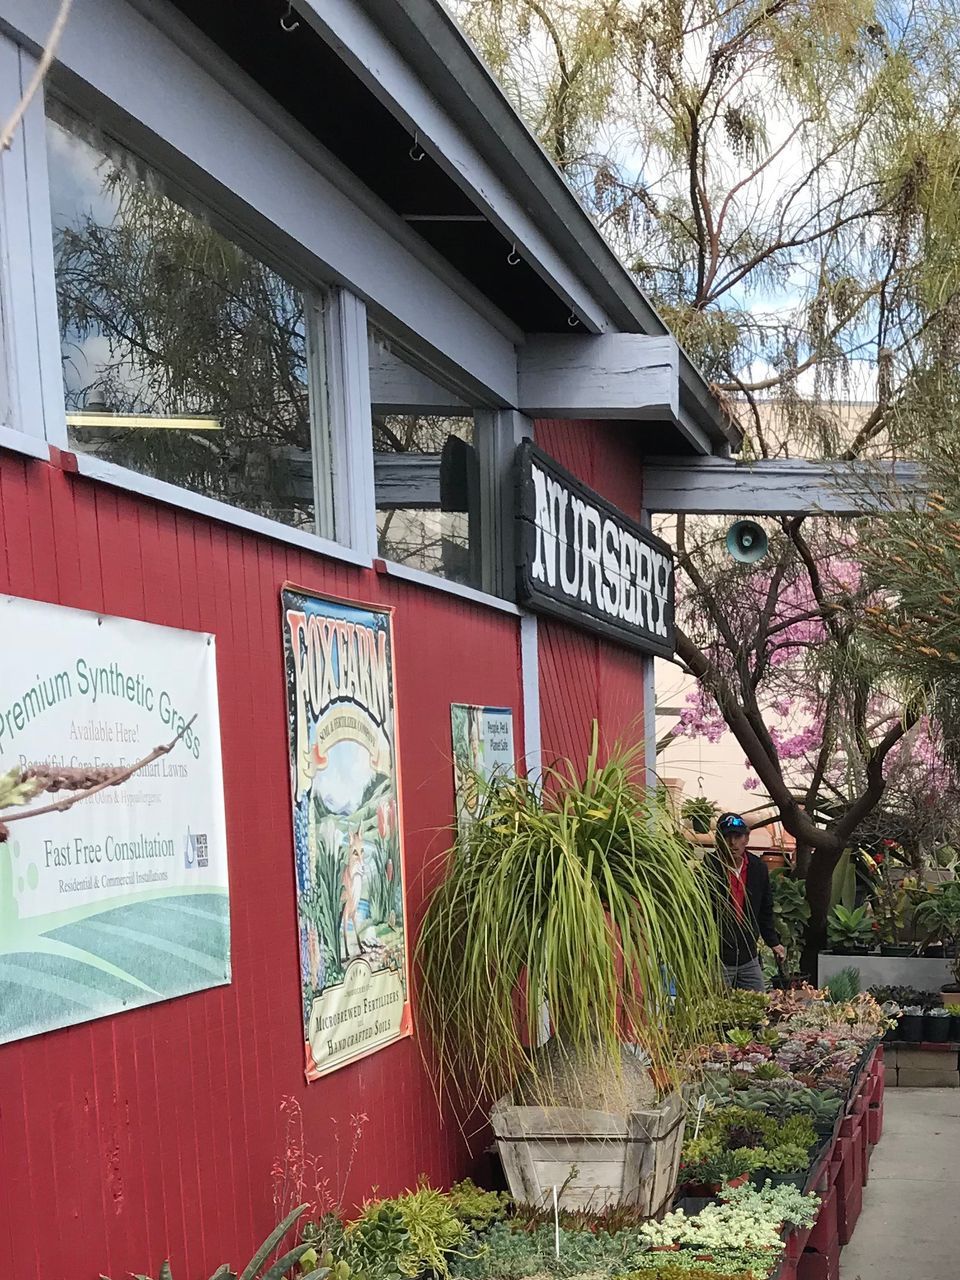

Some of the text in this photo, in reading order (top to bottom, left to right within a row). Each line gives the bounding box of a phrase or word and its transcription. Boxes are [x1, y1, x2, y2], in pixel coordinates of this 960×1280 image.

[531, 463, 672, 638] NURSERY
[0, 658, 201, 760] Premium Synthetic Grass
[69, 720, 140, 744] Available Here!
[162, 758, 188, 778] Lawns
[43, 832, 175, 868] Fast Free Consultation
[58, 870, 169, 893] Residential & Commercial Installations
[315, 1004, 361, 1033] MICROBREWED
[363, 990, 399, 1014] FERTILIZERS
[327, 1019, 391, 1056] HANDCRAFTED SOILS
